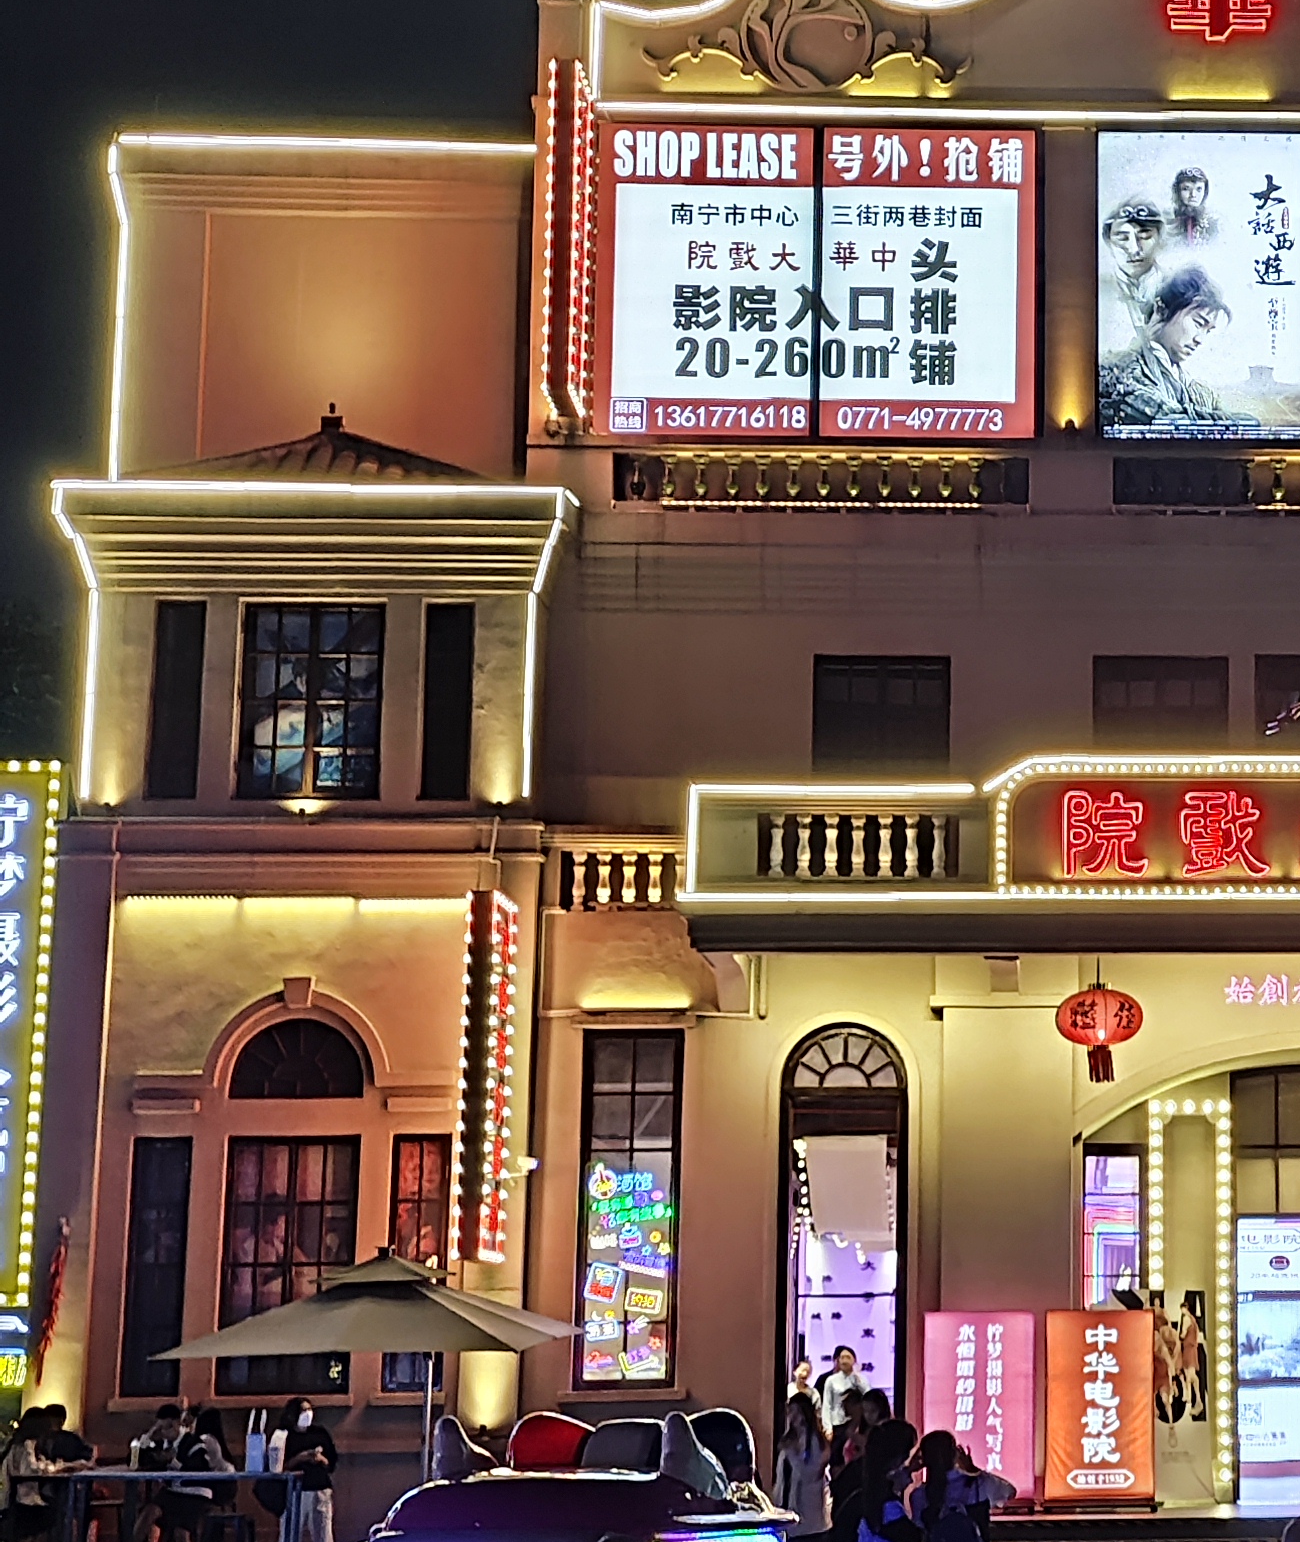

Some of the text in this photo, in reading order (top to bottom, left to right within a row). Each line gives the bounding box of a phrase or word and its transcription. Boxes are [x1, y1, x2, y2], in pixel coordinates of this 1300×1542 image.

[613, 129, 798, 180] SHOP LEASE
[670, 202, 983, 229] 南宁市中心 三街两巷封面
[672, 285, 895, 333] 影院入口
[909, 238, 958, 386] 头排铺
[614, 401, 642, 414] 招商
[654, 405, 1003, 432] 13617716118 0771-4977773
[1081, 1323, 1121, 1464] 中华电影院
